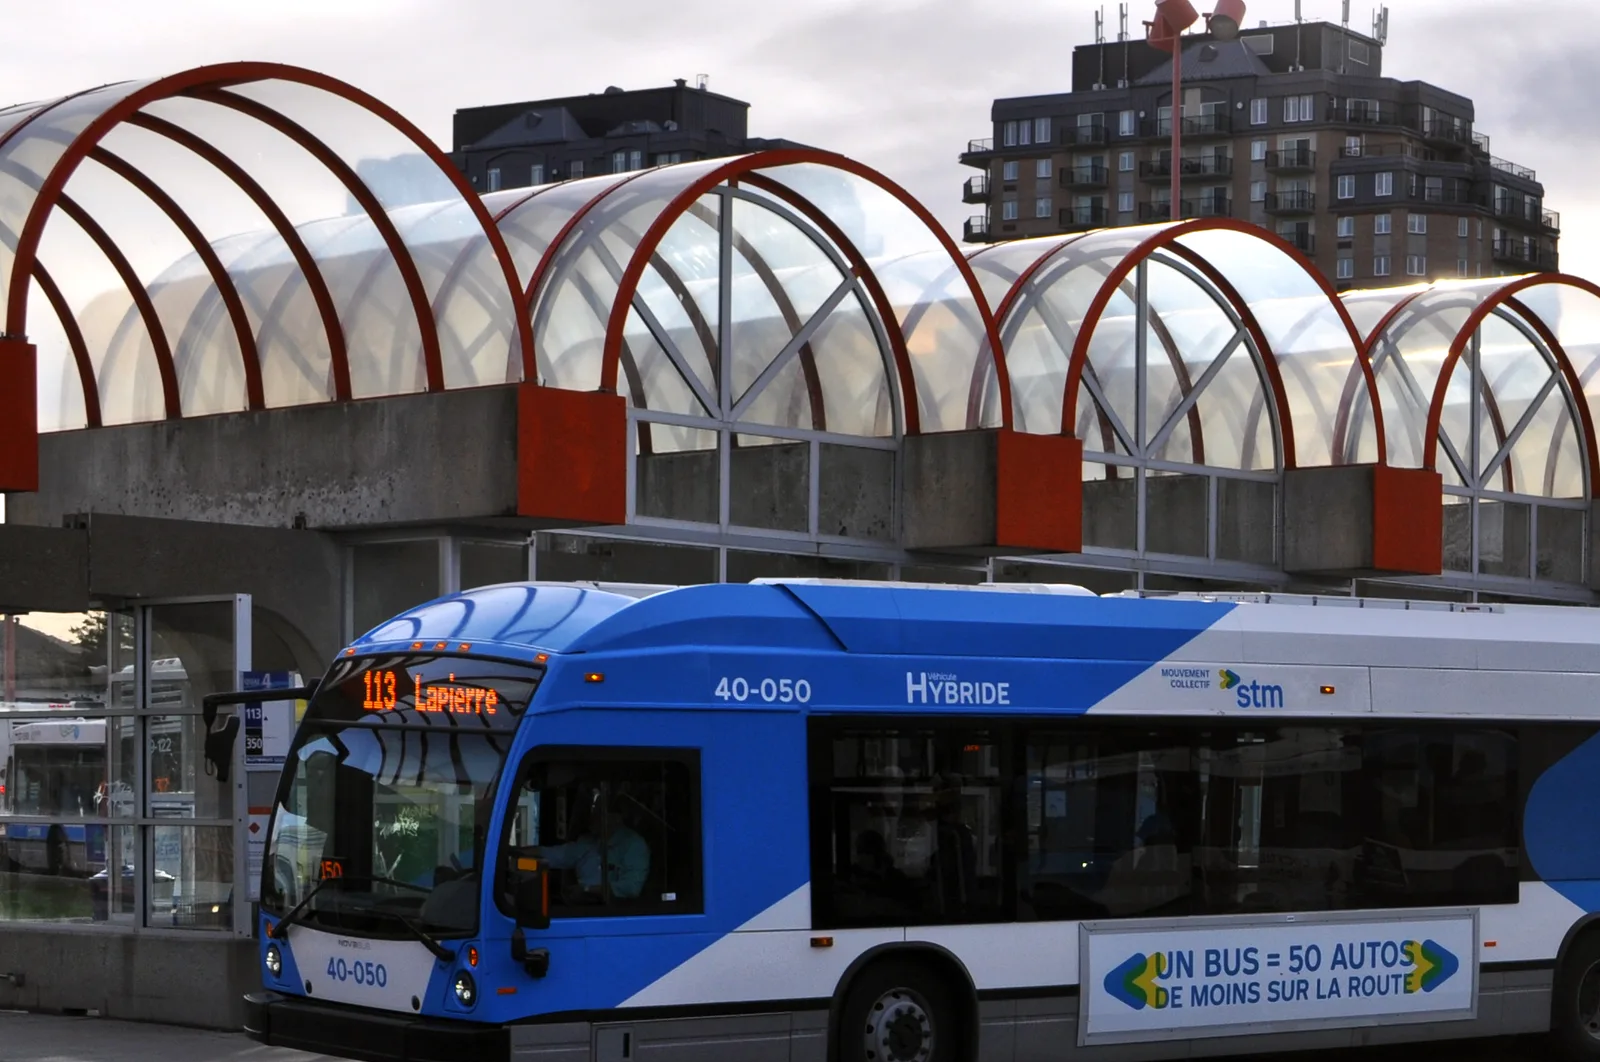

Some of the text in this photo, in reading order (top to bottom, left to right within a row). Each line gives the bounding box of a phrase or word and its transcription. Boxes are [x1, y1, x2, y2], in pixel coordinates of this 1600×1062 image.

[262, 673, 271, 688] 4
[1161, 668, 1210, 679] MOUVEMENT
[1170, 679, 1210, 689] COLLECTIF
[363, 670, 498, 715] 113 Lapierre
[714, 677, 812, 703] 40-050
[906, 671, 1010, 705] HYBRIDE
[1236, 680, 1284, 708] stm
[246, 708, 262, 719] 113
[246, 738, 262, 749] 350
[327, 957, 387, 988] 40-050
[1155, 940, 1415, 981] UN BUS = 50 AUTOS
[1155, 973, 1414, 1010] DE MOINS SUR LA ROUTE
